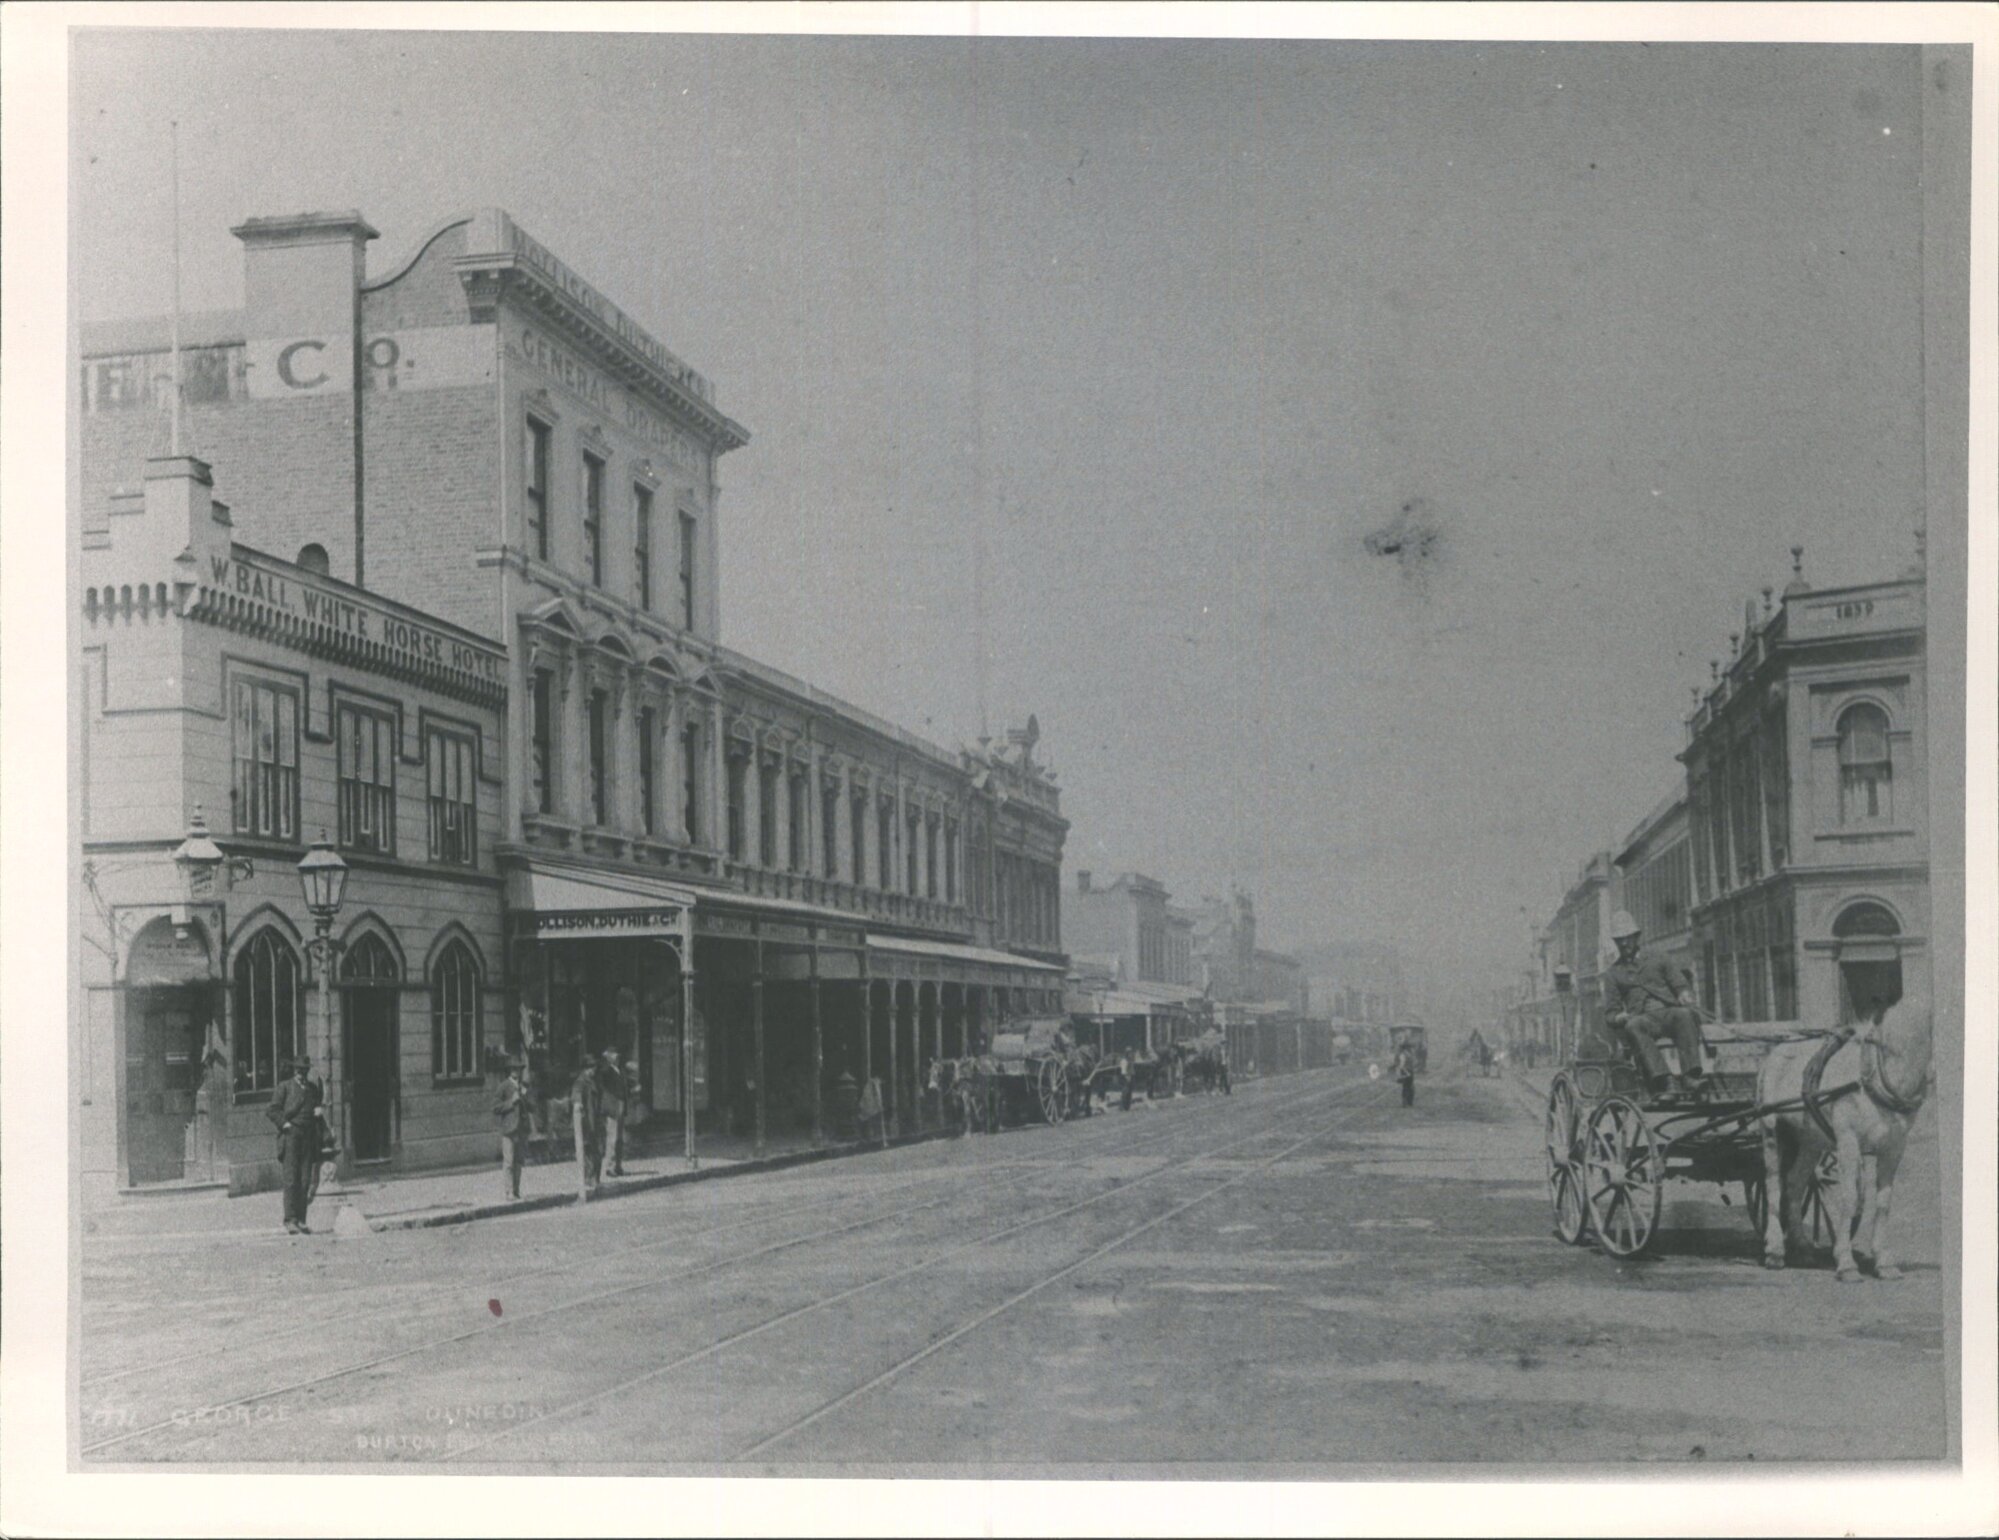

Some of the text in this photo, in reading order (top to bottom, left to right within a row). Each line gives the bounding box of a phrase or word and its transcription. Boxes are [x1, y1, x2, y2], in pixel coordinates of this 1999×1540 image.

[521, 328, 609, 408] GENERAL
[303, 591, 369, 638] WHITE
[384, 619, 443, 663] HORSE
